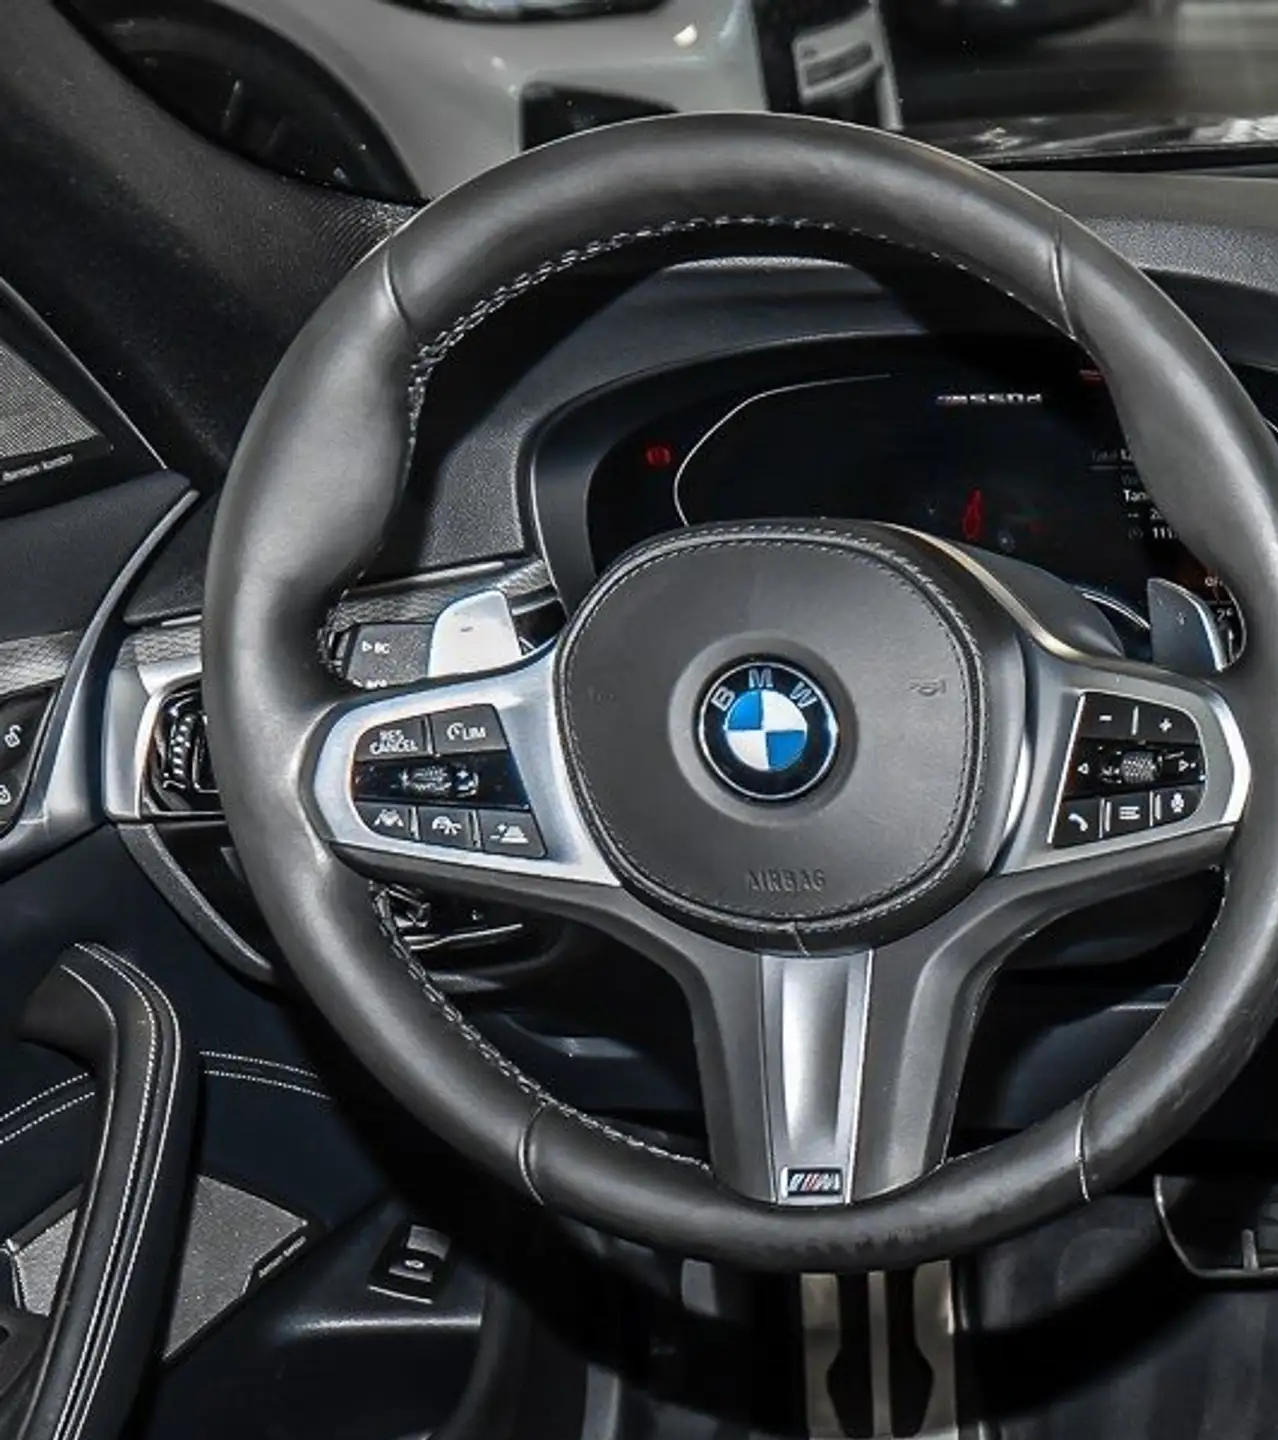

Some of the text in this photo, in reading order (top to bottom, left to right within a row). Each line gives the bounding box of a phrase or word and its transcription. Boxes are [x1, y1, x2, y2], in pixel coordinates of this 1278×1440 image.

[711, 667, 818, 712] BMW
[463, 725, 487, 740] LIM
[369, 738, 419, 756] CANCEL
[748, 869, 827, 893] AIRBAG
